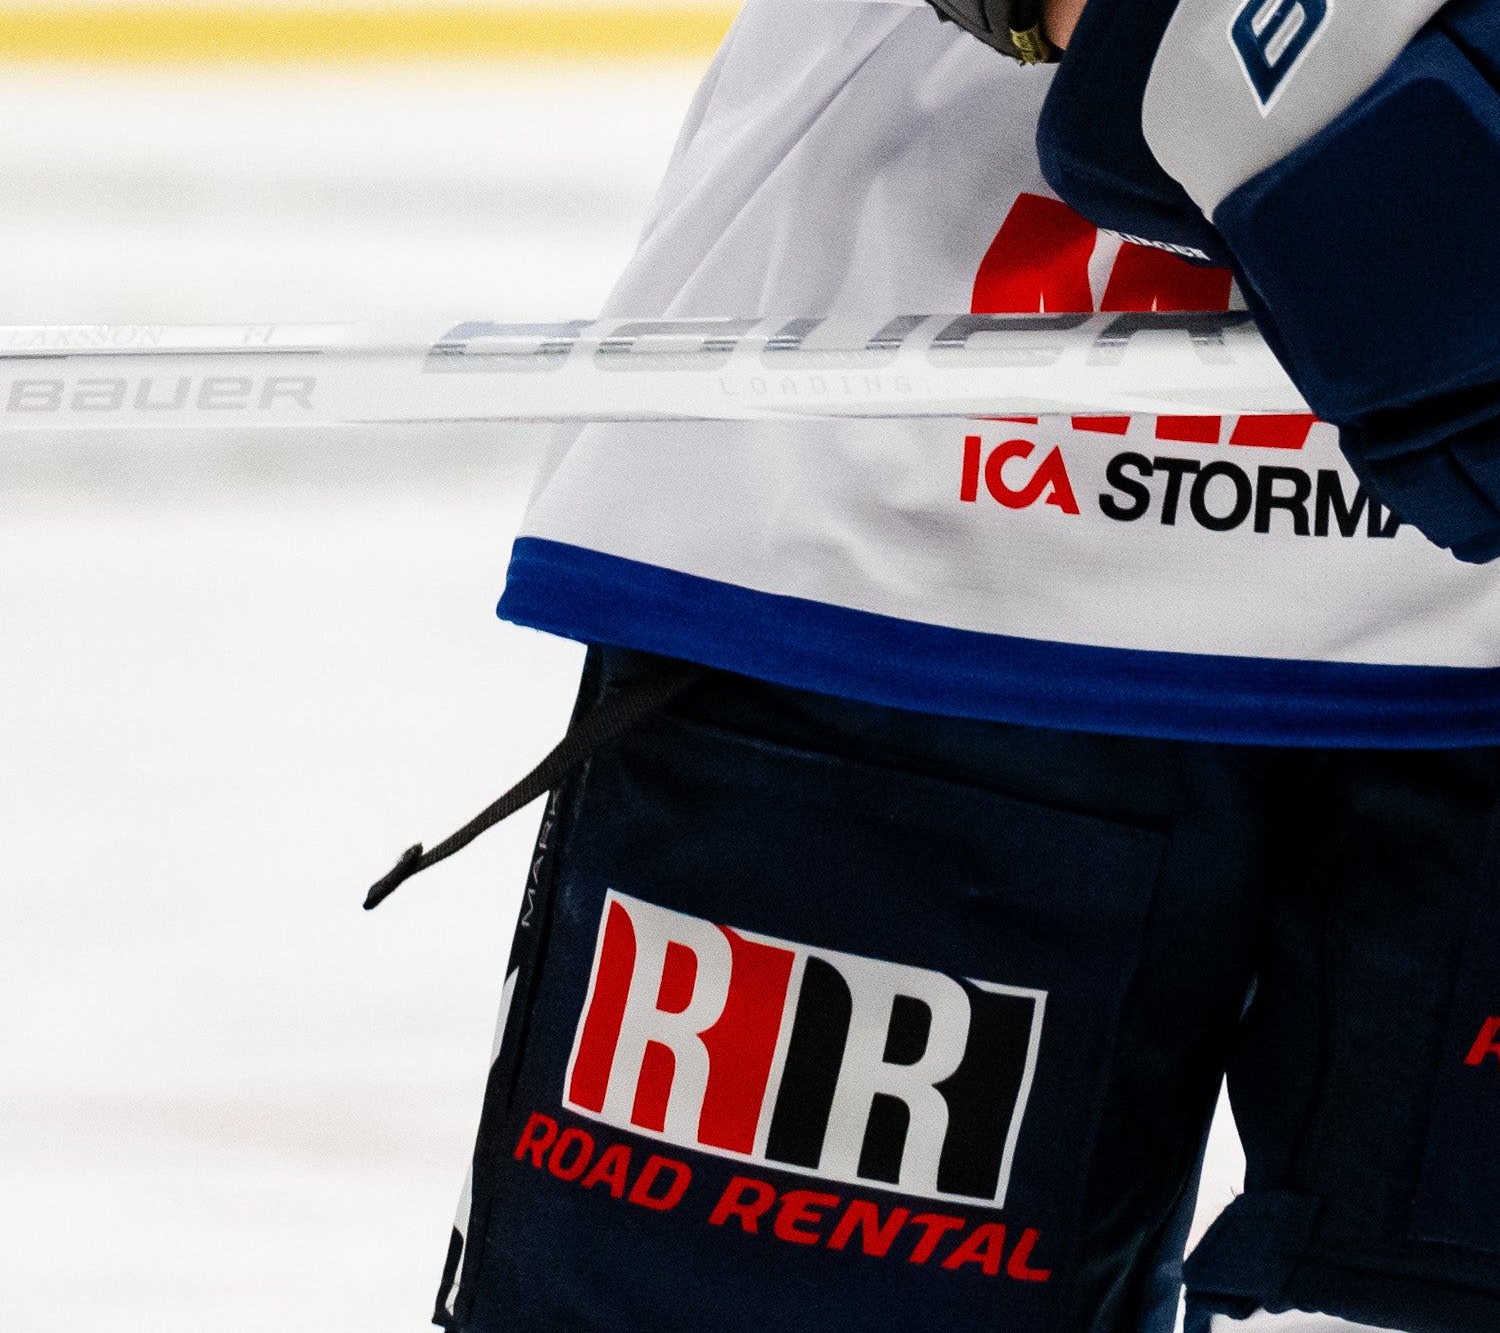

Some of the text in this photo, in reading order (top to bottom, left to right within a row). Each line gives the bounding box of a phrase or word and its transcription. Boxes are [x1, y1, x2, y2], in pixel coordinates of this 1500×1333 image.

[5, 376, 317, 412] BAUER
[960, 435, 1401, 539] ICA STORM
[513, 1111, 1053, 1282] ROAD RENTAL
